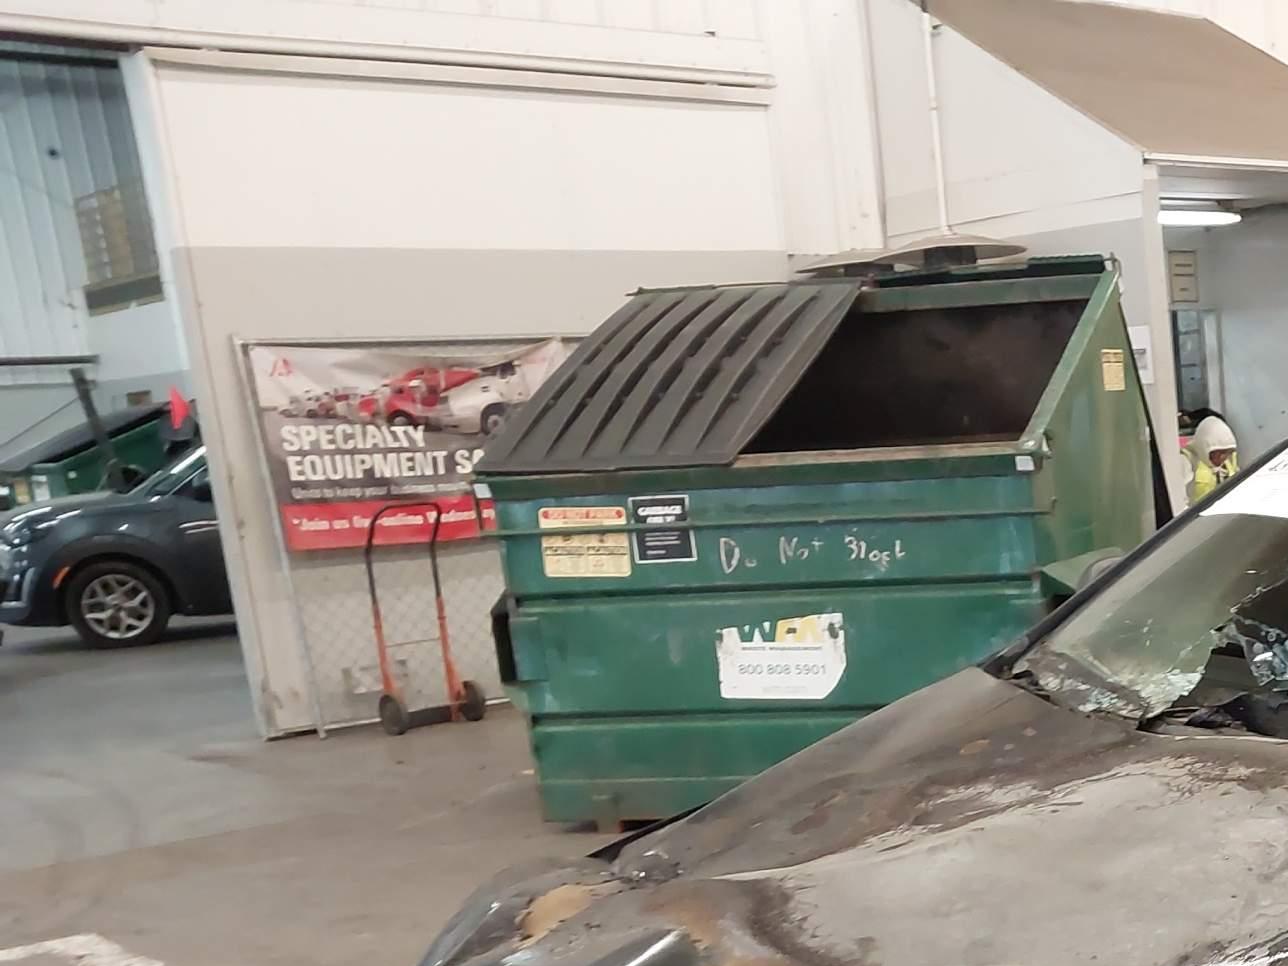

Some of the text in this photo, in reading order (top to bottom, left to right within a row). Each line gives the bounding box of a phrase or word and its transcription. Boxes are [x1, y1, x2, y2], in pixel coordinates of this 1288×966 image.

[281, 423, 426, 450] SPECIALTY
[287, 451, 448, 481] EQUIPMENT
[719, 537, 757, 574] Do
[737, 663, 827, 675] 800 808 5901
